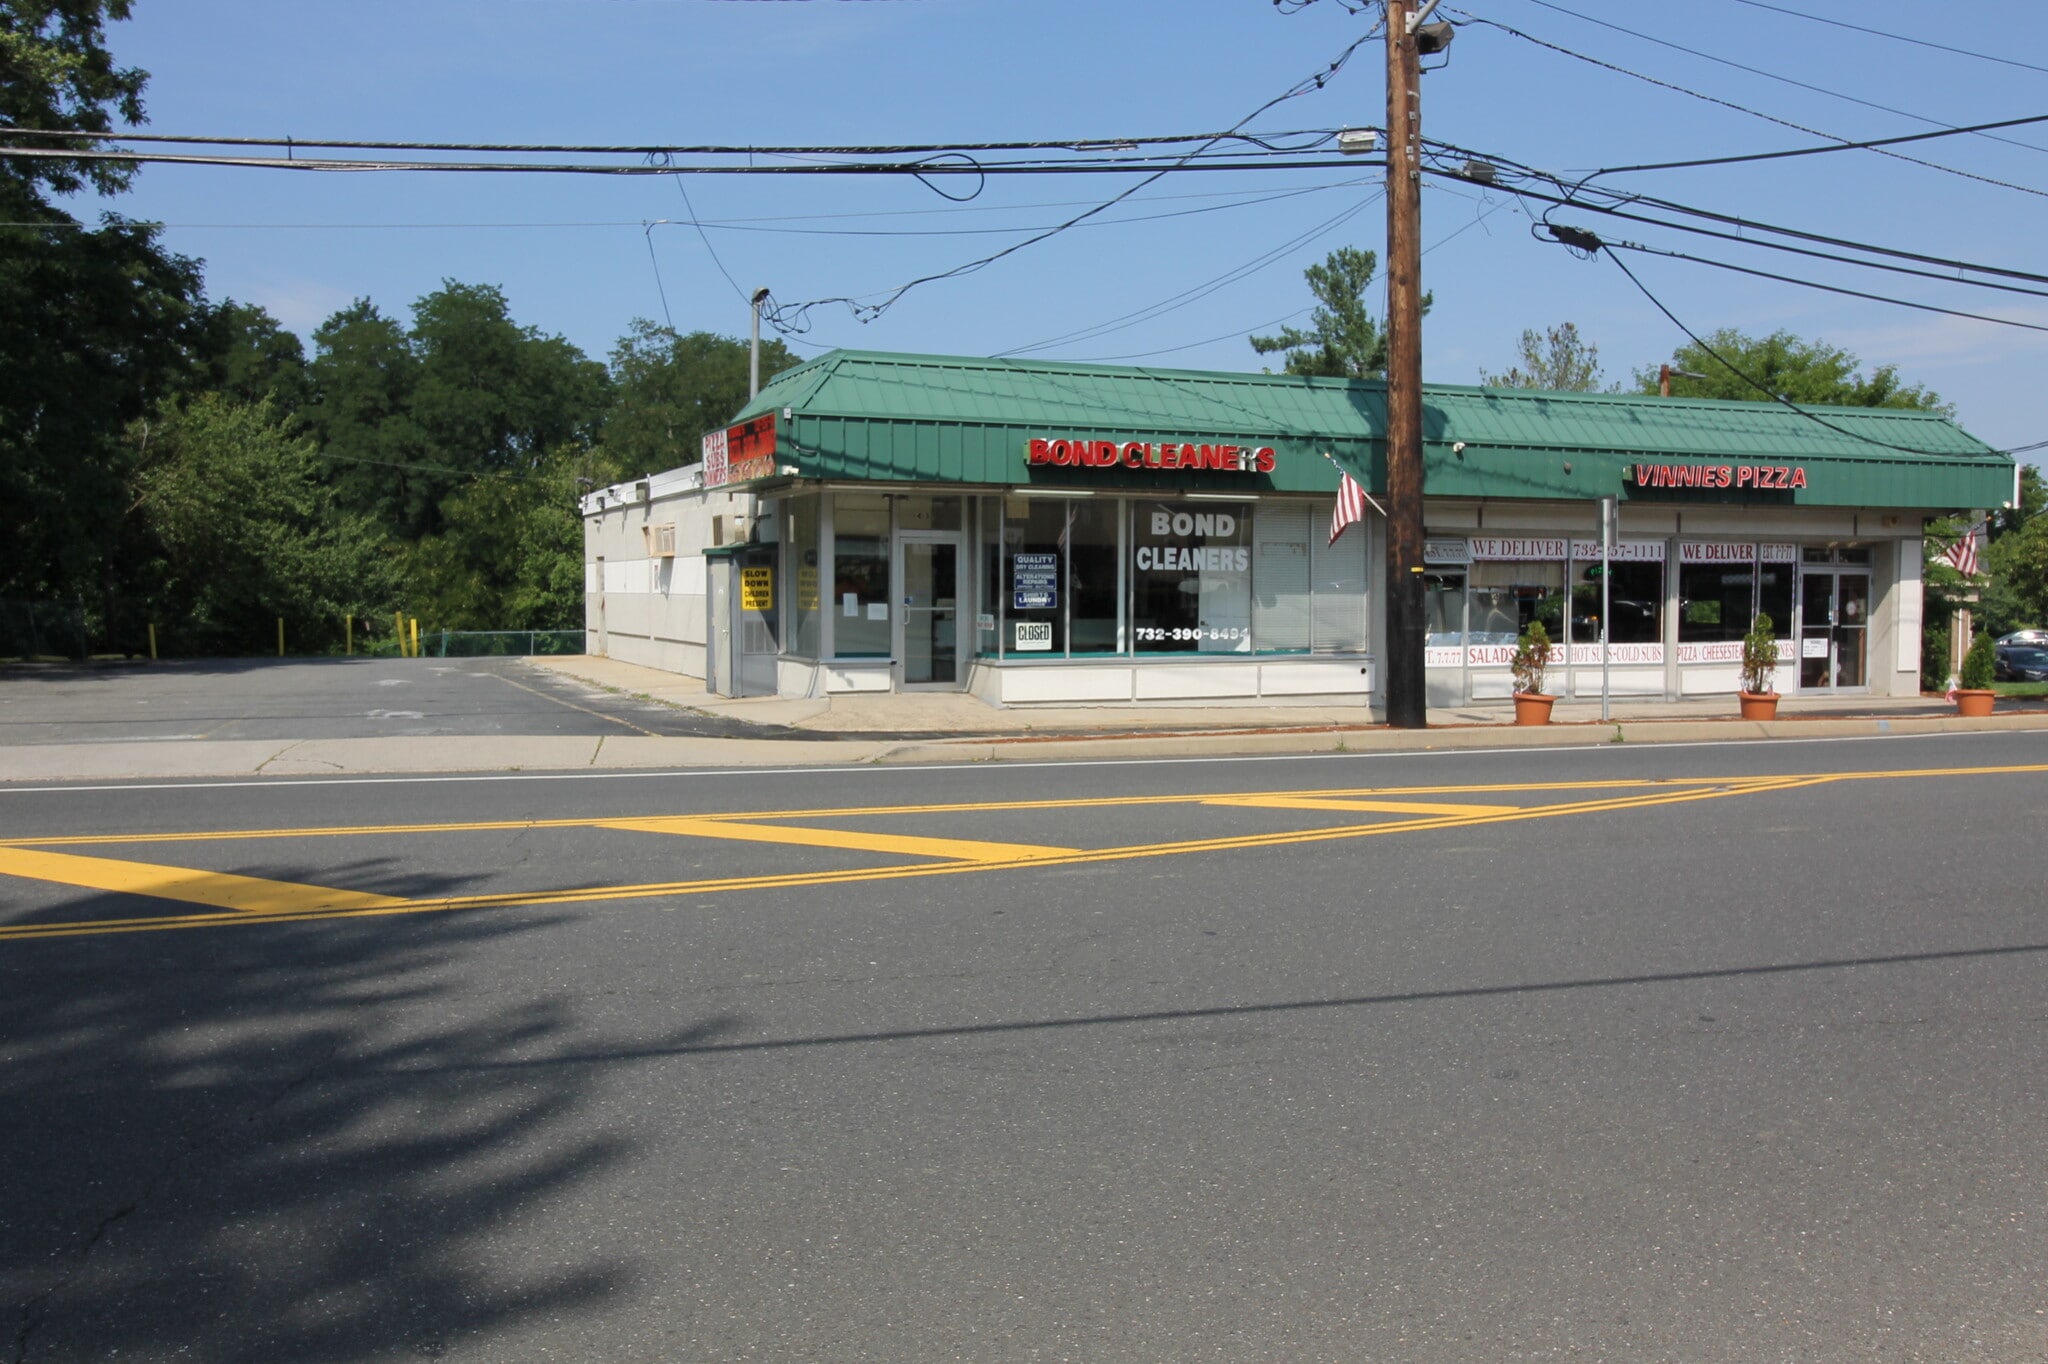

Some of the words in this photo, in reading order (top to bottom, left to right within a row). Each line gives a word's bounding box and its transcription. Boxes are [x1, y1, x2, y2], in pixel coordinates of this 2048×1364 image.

[1029, 438, 1117, 467] BOND
[1122, 442, 1276, 472] CLEANERS
[1636, 464, 1732, 487] VINNIES
[1737, 466, 1807, 488] PIZZA
[1151, 512, 1235, 537] BOND
[1473, 540, 1495, 555] WE
[1501, 540, 1563, 556] DELIVER
[1573, 543, 1662, 558] 732-57-1111
[1682, 544, 1701, 559] WE
[1705, 544, 1753, 559] DELIVER
[1137, 546, 1249, 572] CLEANERS
[744, 570, 768, 578] SLOW
[1018, 625, 1049, 640] CLOSED
[1136, 628, 1248, 641] 732-390-8494
[1469, 648, 1517, 663] SALADS
[1572, 646, 1588, 662] HOT
[1592, 646, 1613, 662] SUS
[1641, 645, 1662, 661] SUBS
[1677, 646, 1697, 661] PIZZA
[1702, 644, 1745, 660] CHEESESTEA
